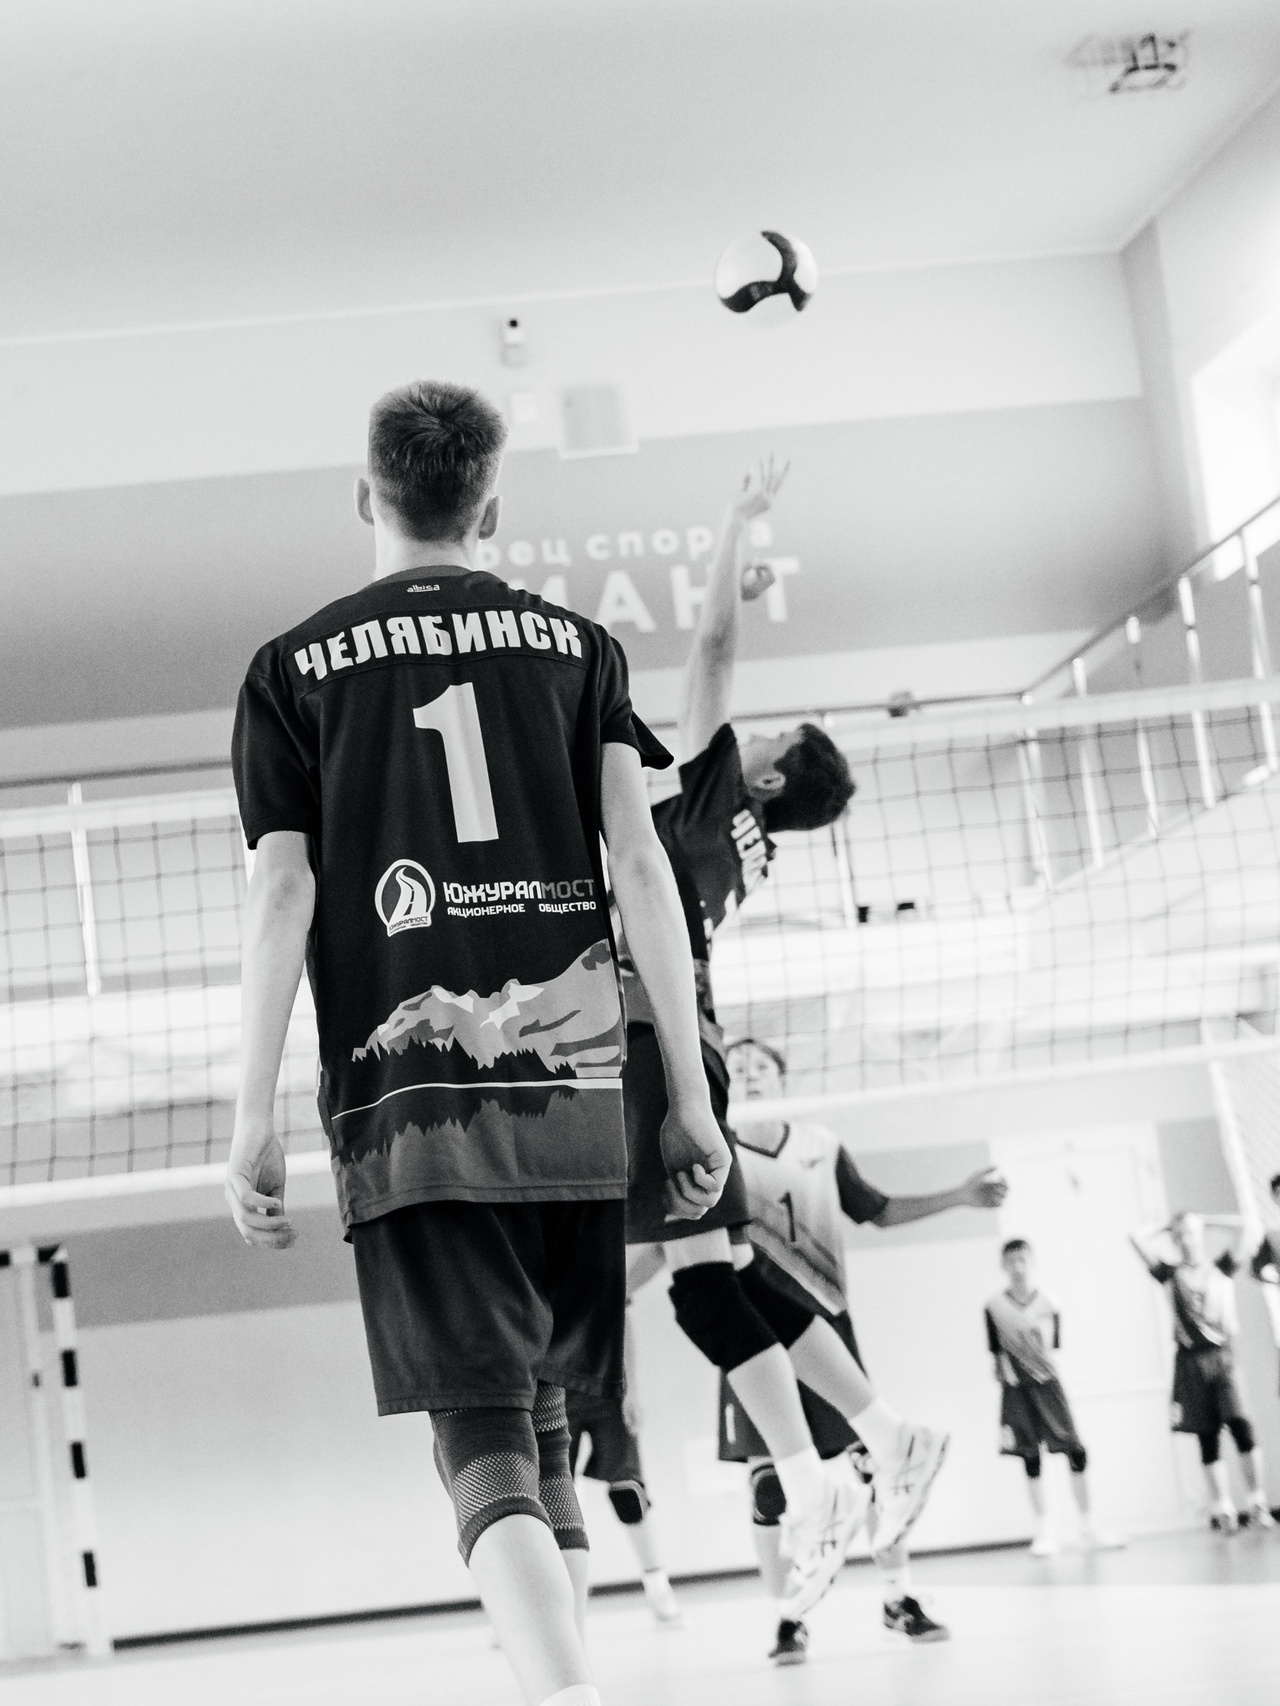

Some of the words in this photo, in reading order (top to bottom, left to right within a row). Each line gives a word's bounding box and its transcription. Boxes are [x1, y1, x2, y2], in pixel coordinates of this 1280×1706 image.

[586, 520, 772, 561] спора
[294, 610, 582, 680] ЧЕЛЯБИНСК
[412, 682, 499, 843] 1
[443, 879, 595, 904] ЮЖУРАЛМОСТ
[447, 903, 526, 918] АКЦИОНЕРНОЕ
[538, 900, 597, 914] ОБЩЕСТВО
[778, 1192, 797, 1243] 1
